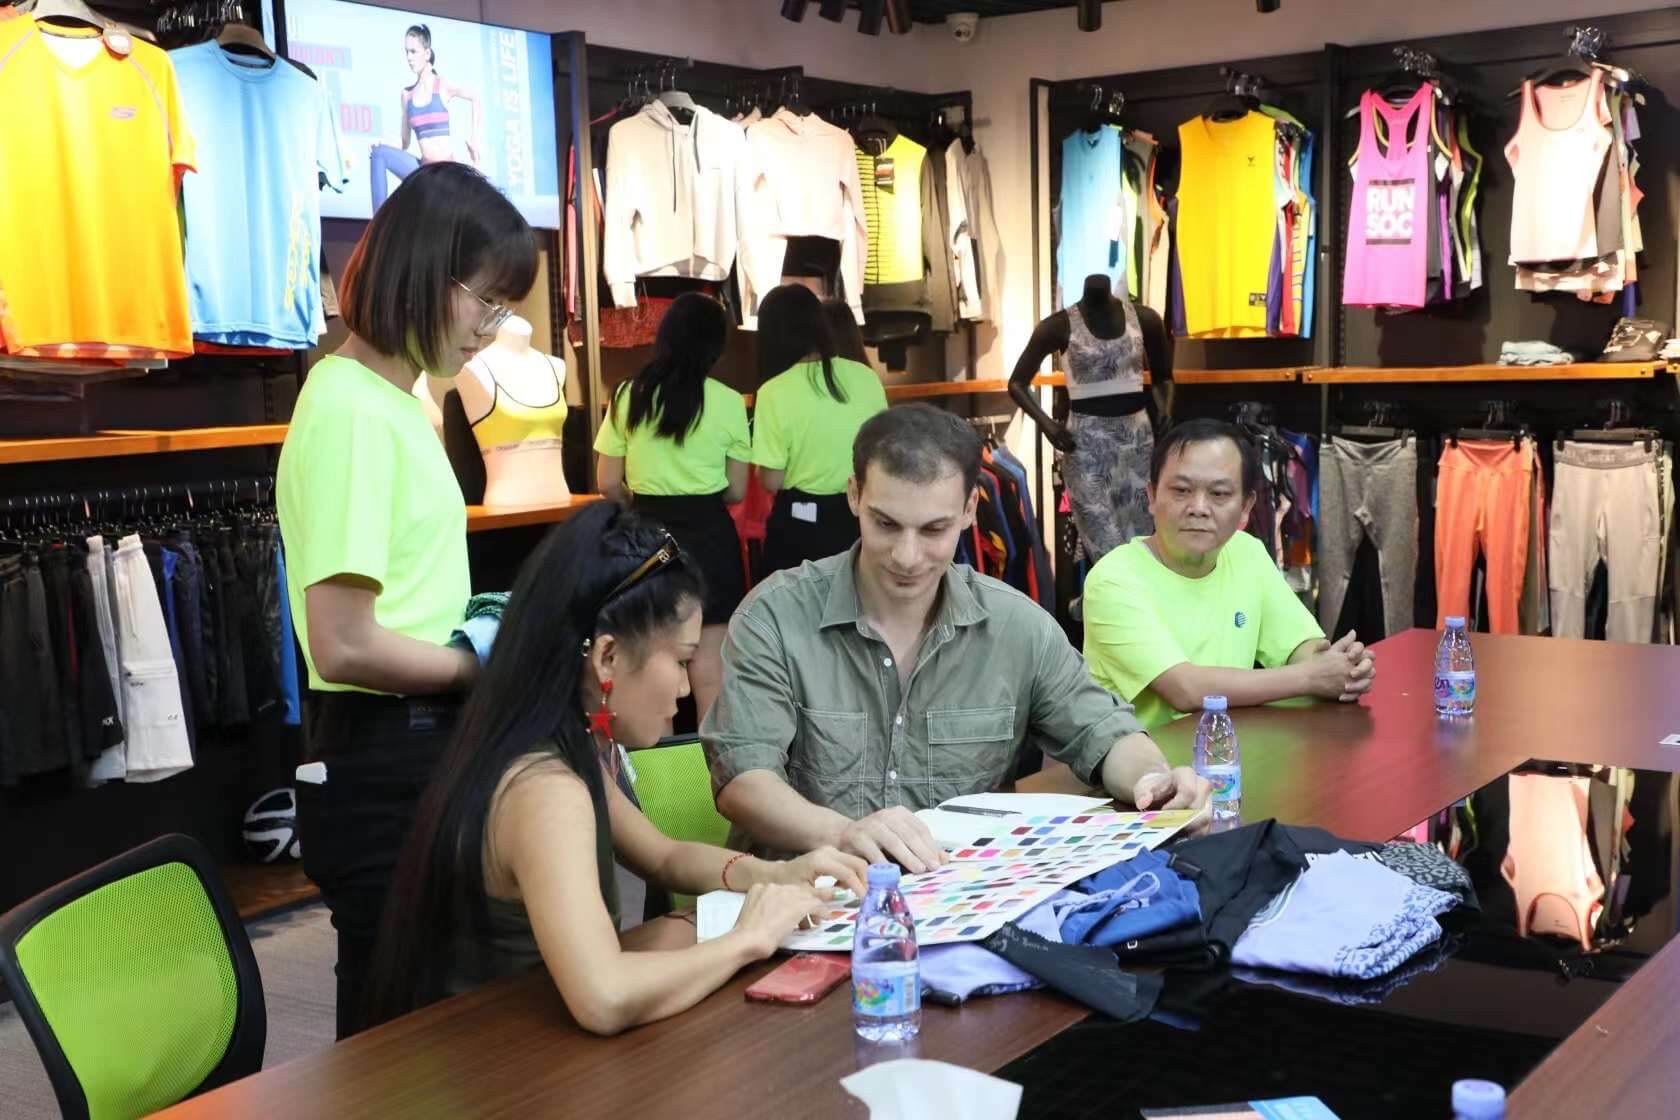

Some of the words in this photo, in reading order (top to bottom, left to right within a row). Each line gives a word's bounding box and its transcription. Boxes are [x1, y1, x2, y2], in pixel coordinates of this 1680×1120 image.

[498, 31, 518, 82] LIFE
[340, 103, 373, 132] DID
[1366, 186, 1416, 211] RUN
[1366, 211, 1414, 237] SOC
